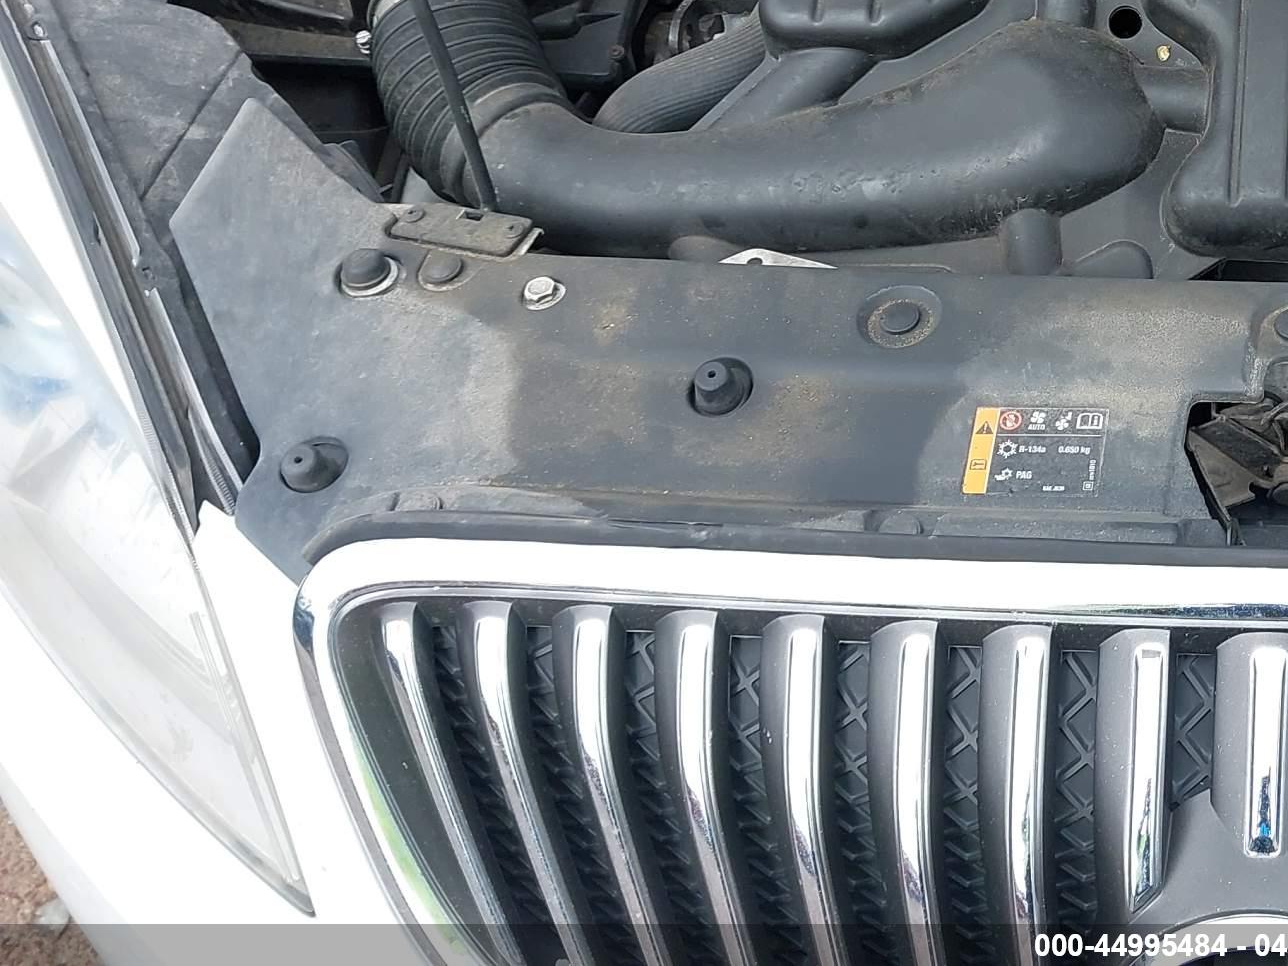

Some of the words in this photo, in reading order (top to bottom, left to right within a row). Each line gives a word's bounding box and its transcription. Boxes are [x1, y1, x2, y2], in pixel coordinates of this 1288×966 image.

[1027, 423, 1046, 431] AUTO
[1018, 445, 1047, 453] R-134a
[1080, 445, 1091, 455] kg
[1015, 470, 1033, 480] PAG
